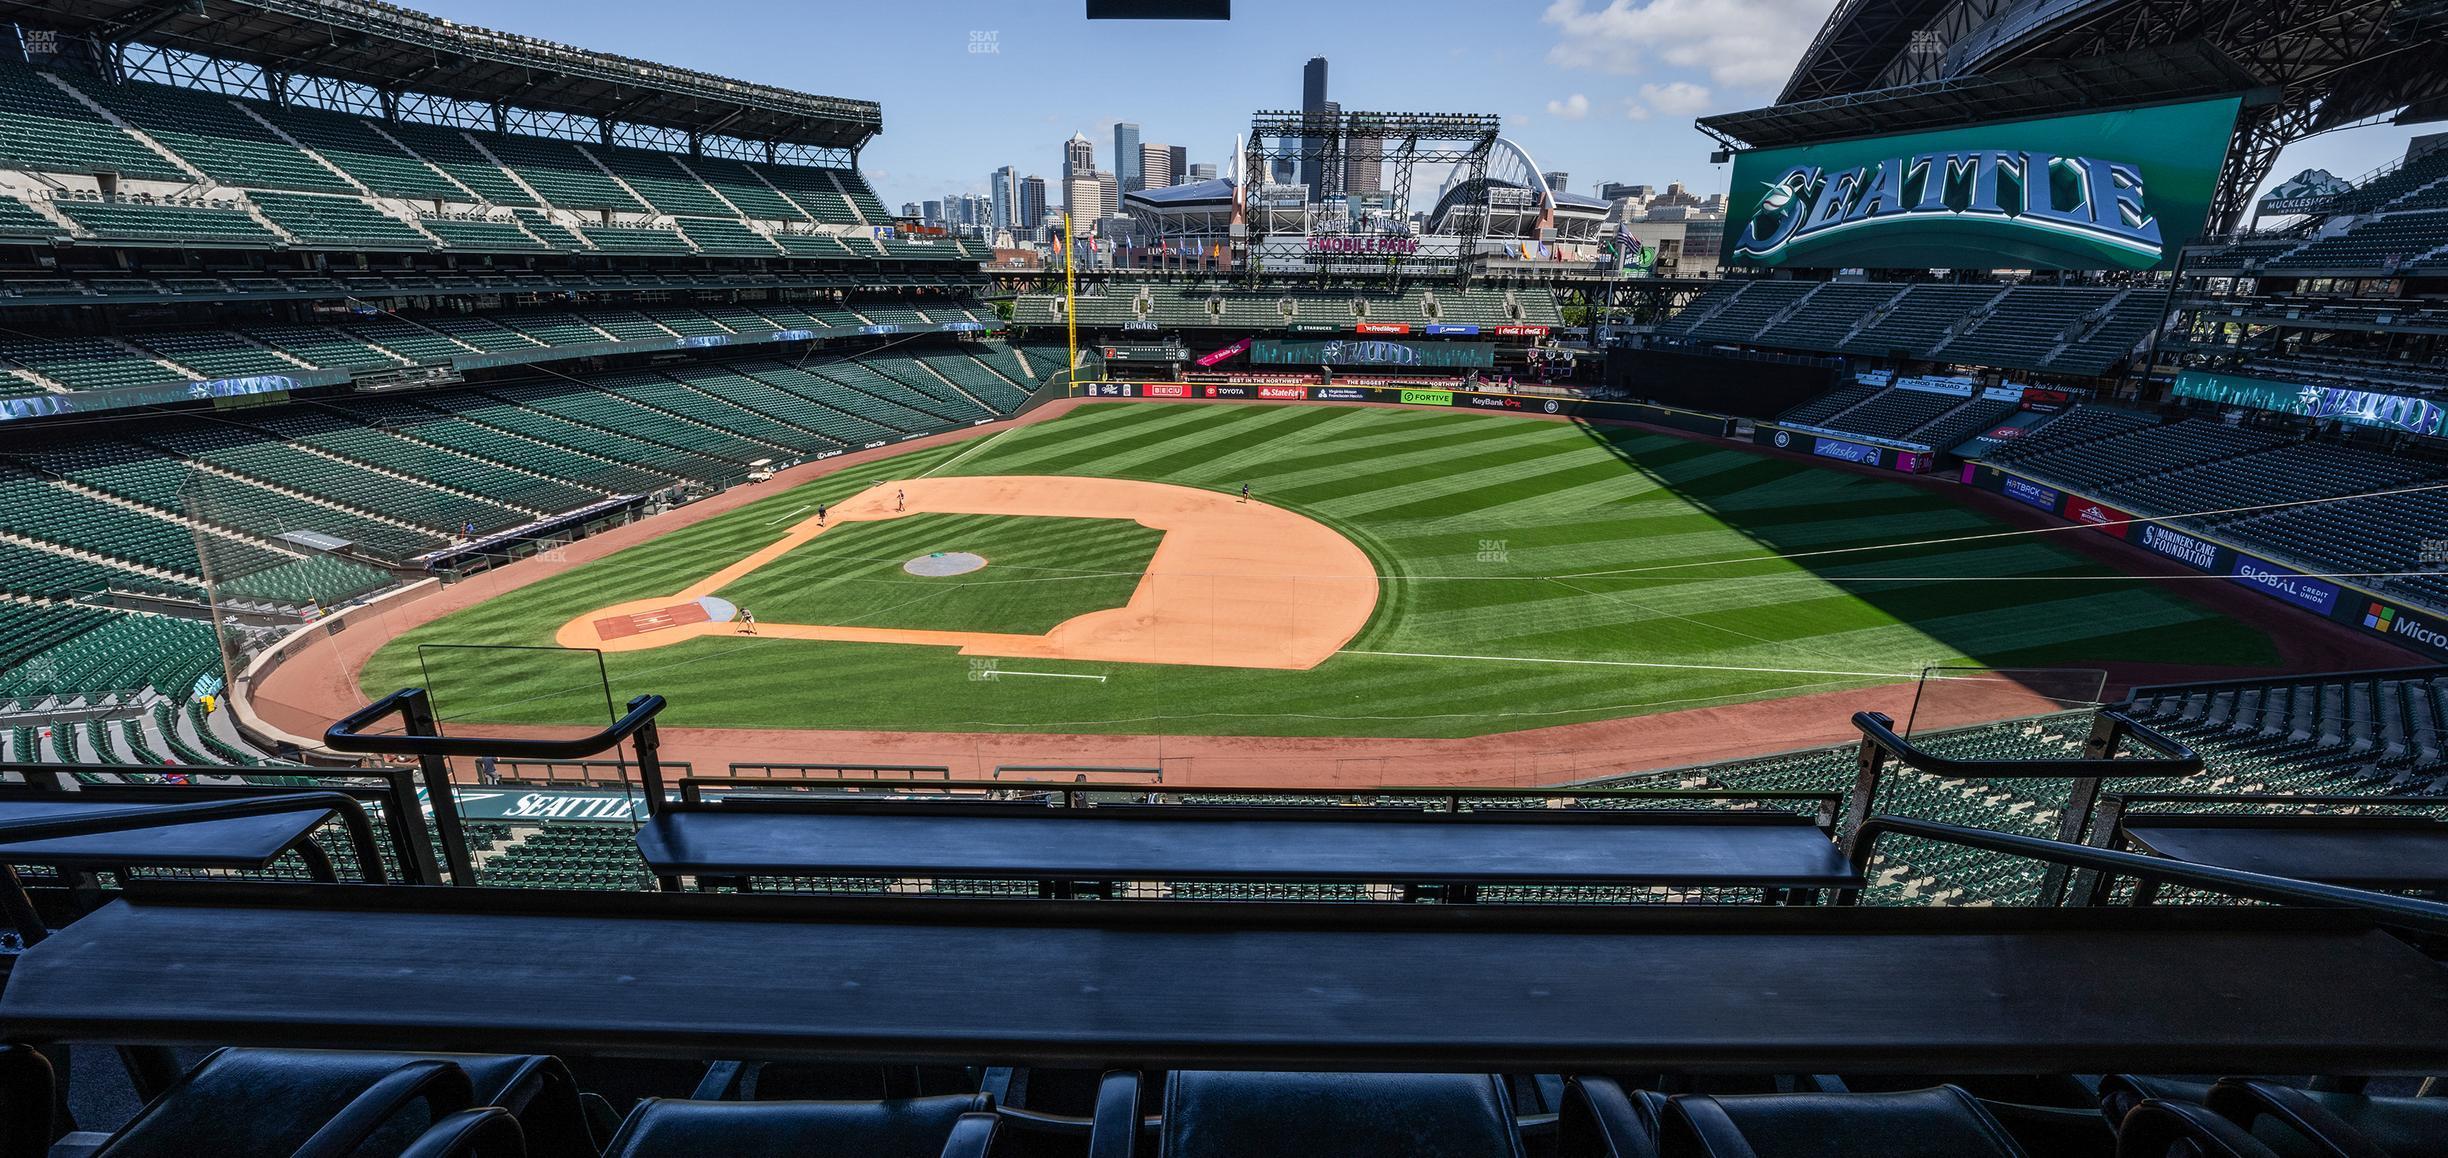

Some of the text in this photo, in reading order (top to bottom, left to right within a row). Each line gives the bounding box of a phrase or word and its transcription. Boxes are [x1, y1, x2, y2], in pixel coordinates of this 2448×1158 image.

[1733, 150, 2162, 262] SEATTLE
[1307, 238, 1416, 252] T-MOBILE PARK
[1124, 322, 1158, 330] EDGARS
[1415, 393, 1450, 402] FORTIVE
[1472, 397, 1504, 407] KeyBank
[1818, 442, 1859, 460] Alaska
[2006, 478, 2040, 497] HATBACK
[2157, 528, 2217, 557] MARINERS CARE
[2153, 537, 2214, 568] FOUNDATION
[2240, 565, 2297, 595] GLOBAL
[2299, 591, 2324, 604] UNION
[2302, 585, 2329, 599] CREDIT
[502, 793, 643, 818] SEATTLE
